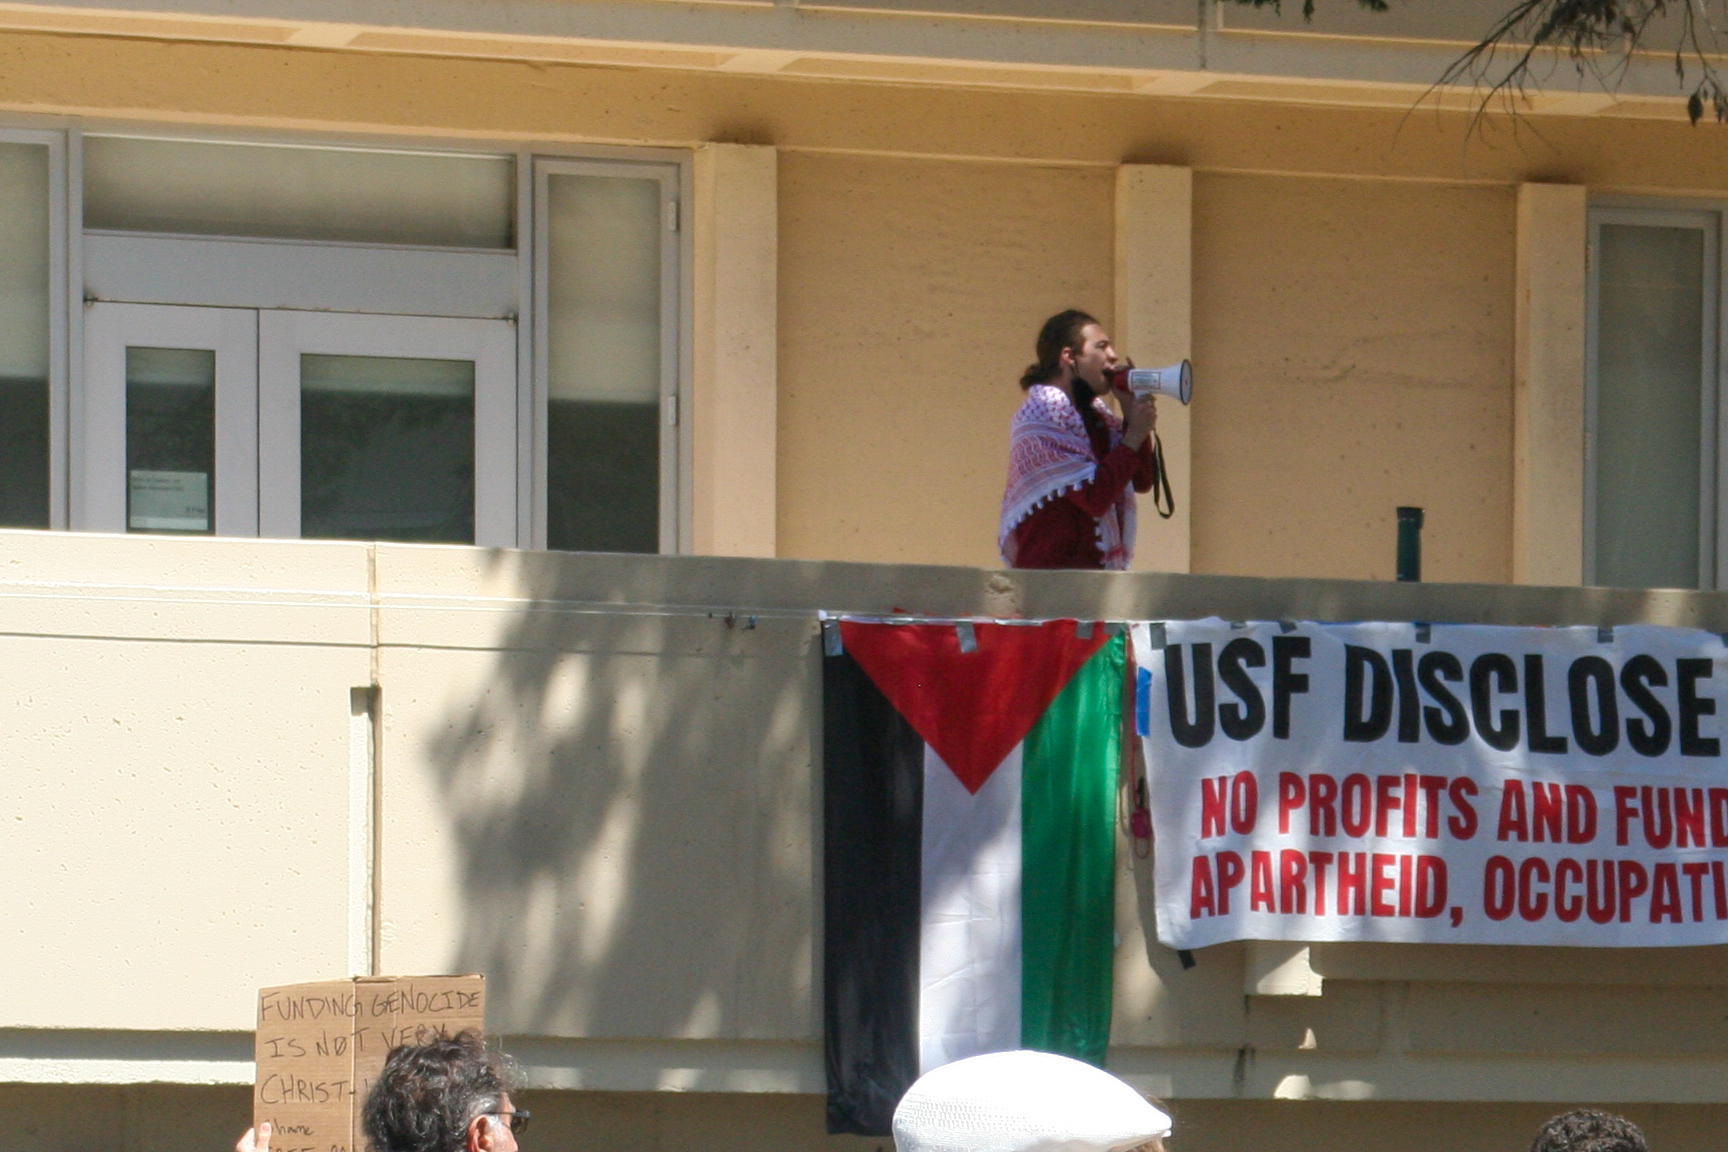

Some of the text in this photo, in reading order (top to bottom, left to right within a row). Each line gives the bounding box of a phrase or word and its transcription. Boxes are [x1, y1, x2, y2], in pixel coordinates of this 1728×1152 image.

[1163, 634, 1312, 749] USF
[1343, 643, 1720, 758] DISCLOSE
[1200, 770, 1257, 840] NO
[1278, 770, 1478, 842] PROFITS
[1497, 777, 1597, 845] AND
[1189, 850, 1463, 929] APARTHEID,
[260, 984, 481, 1021] FUNDING GENOCIDE
[265, 1036, 306, 1058] IS
[316, 1028, 370, 1057] NOT
[265, 1119, 314, 1136] hame
